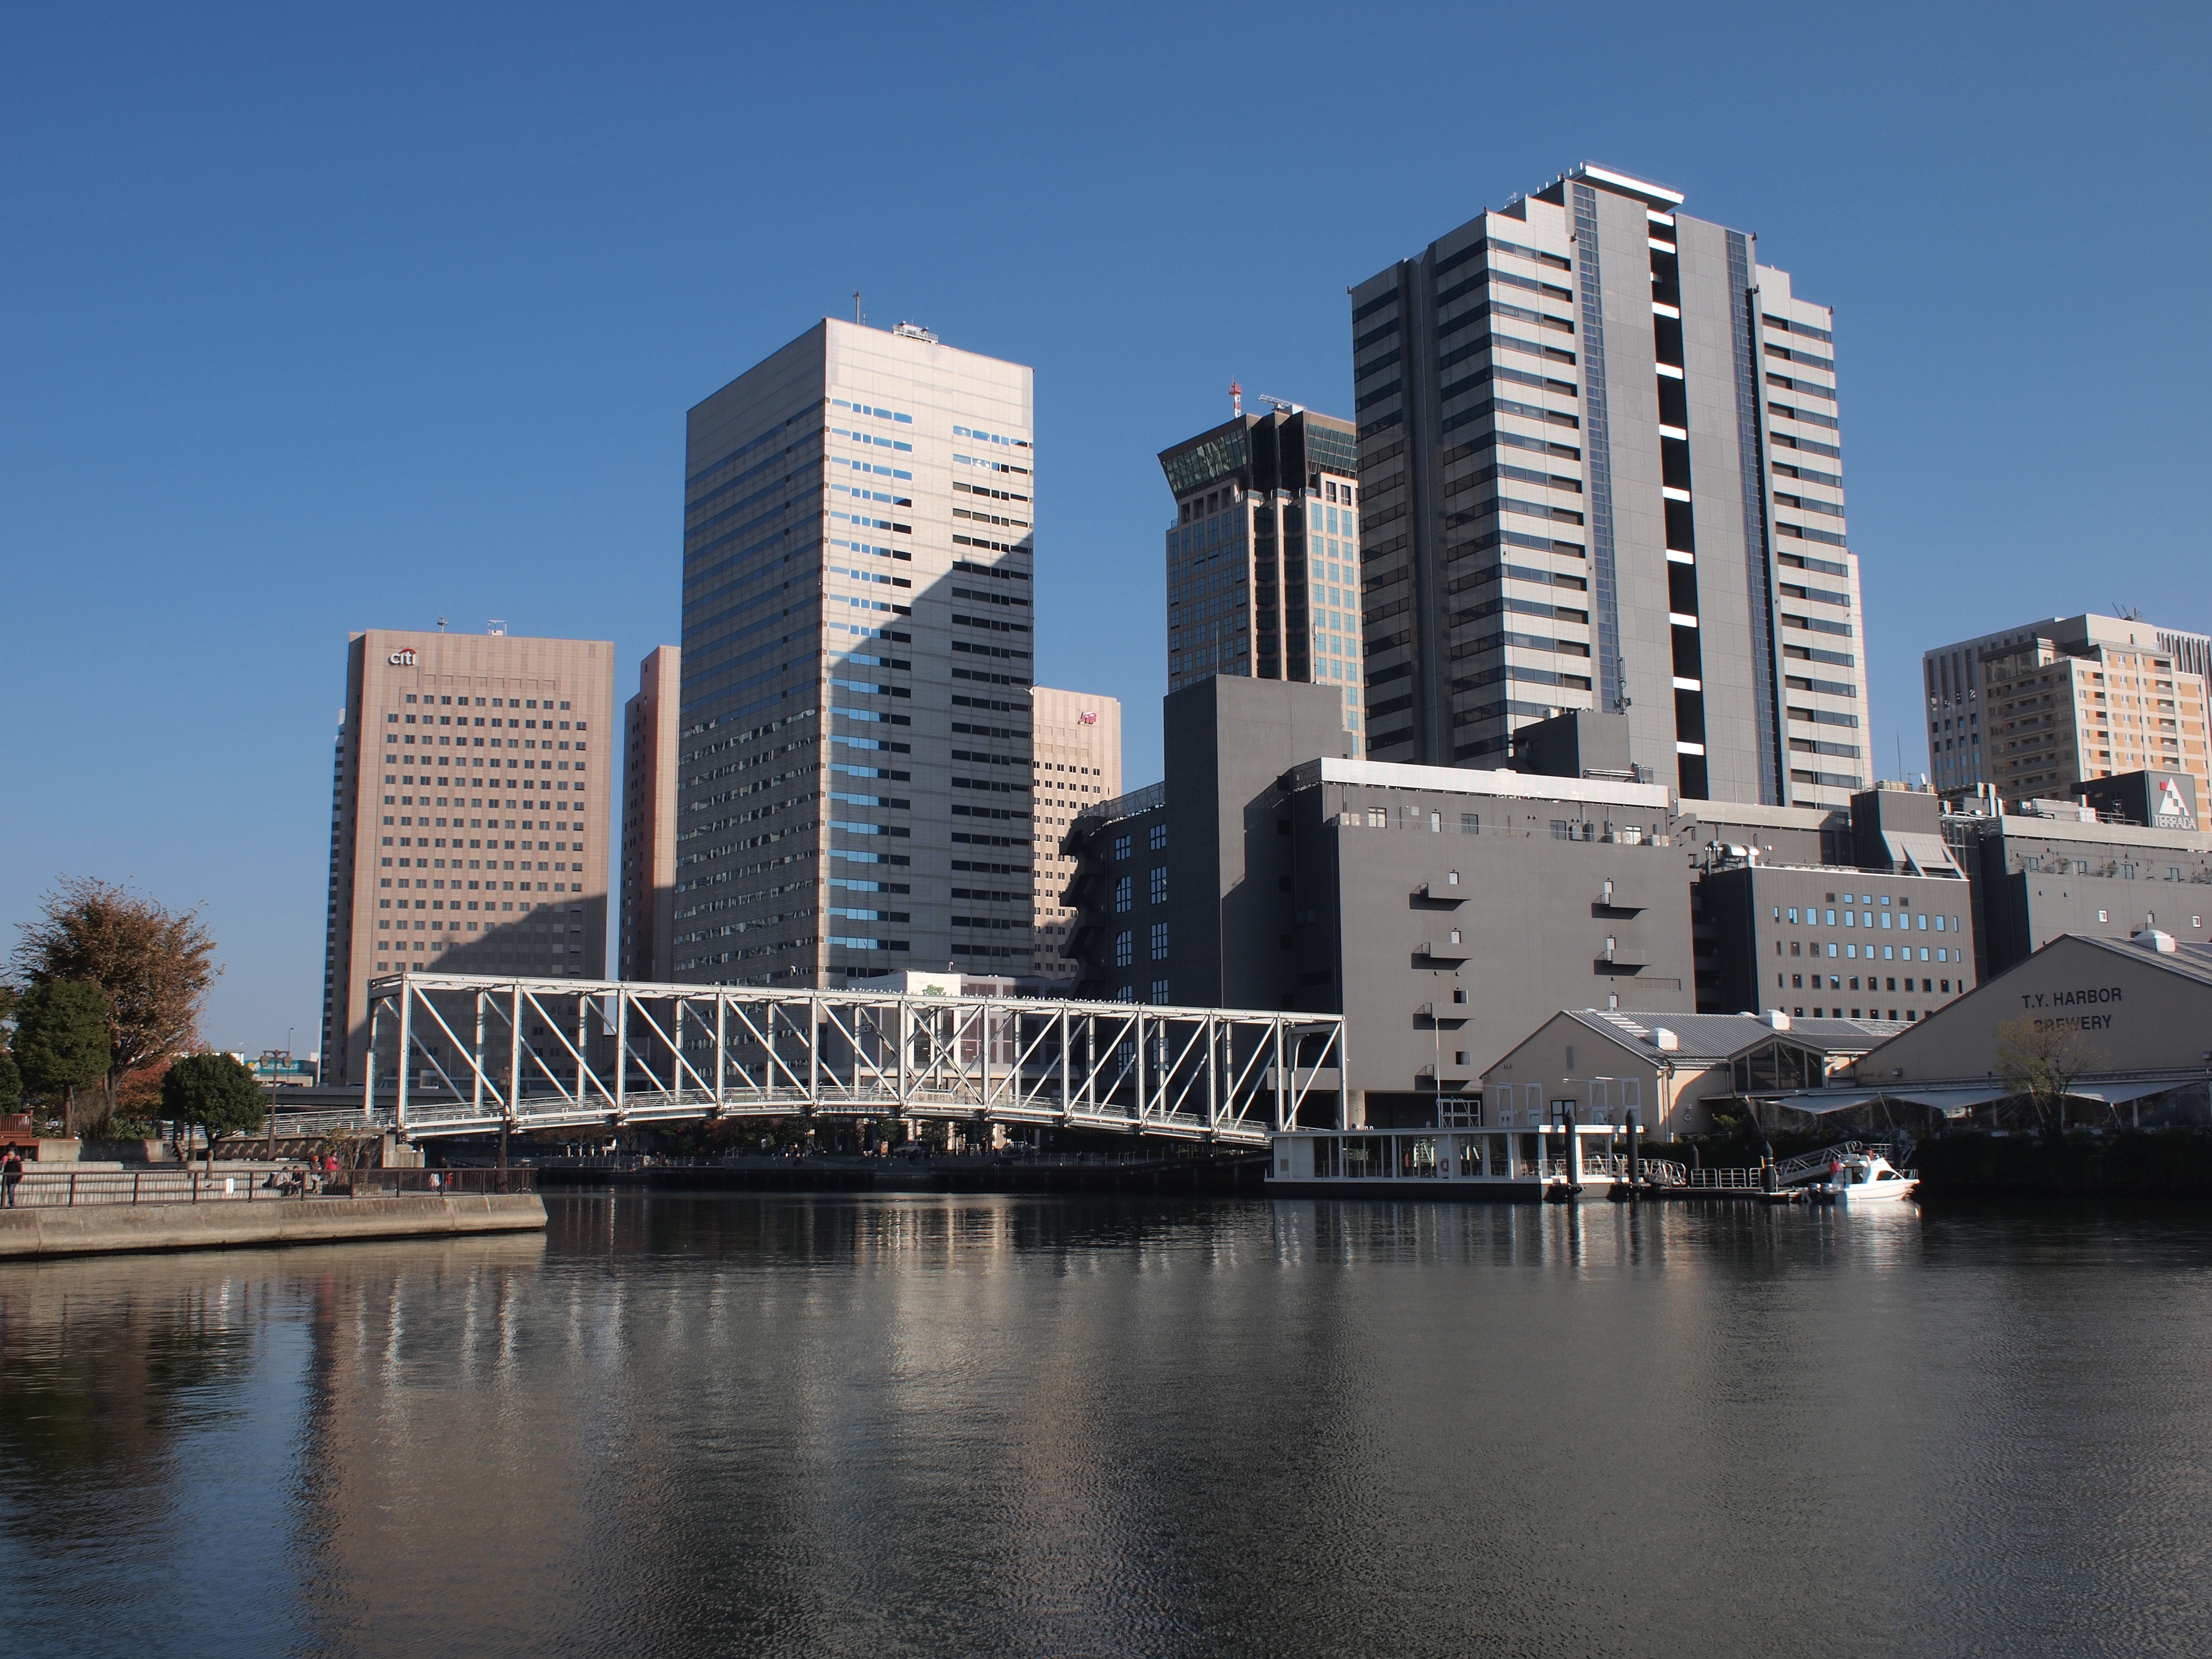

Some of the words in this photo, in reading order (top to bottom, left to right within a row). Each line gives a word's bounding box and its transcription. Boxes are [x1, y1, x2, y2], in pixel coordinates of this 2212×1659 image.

[390, 648, 417, 665] citi
[1079, 712, 1097, 724] JTB
[2153, 815, 2197, 830] TERRADA
[2022, 994, 2049, 1008] T.Y.
[2053, 988, 2121, 1006] HARBOR
[2033, 1015, 2112, 1034] BREWERY
